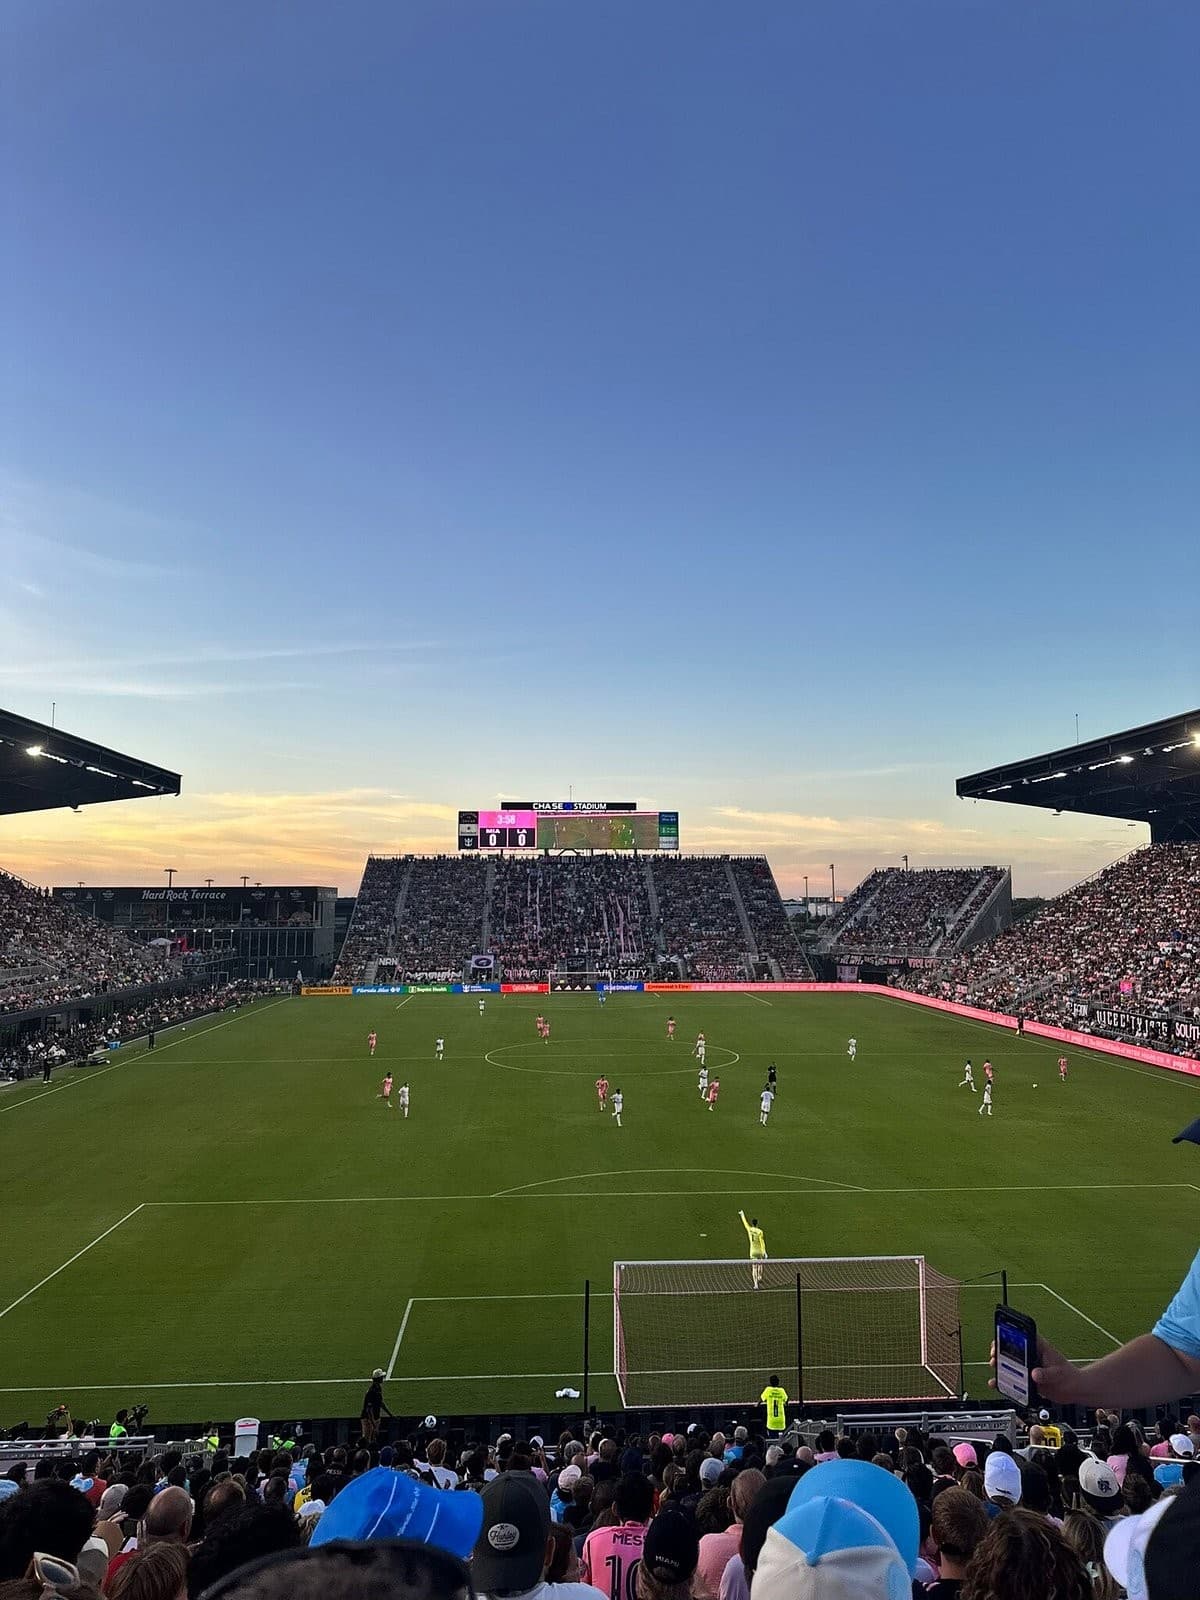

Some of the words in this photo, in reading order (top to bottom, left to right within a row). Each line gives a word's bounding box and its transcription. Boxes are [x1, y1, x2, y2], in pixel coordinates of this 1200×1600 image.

[532, 802, 563, 810] CHASE
[573, 802, 607, 810] STADIUM
[489, 834, 497, 846] 0
[518, 834, 526, 846] 0
[141, 889, 166, 900] Hard
[166, 889, 189, 902] Rock
[191, 889, 226, 900] Terrace
[612, 1532, 642, 1547] MES
[655, 1555, 680, 1568] MIAMI
